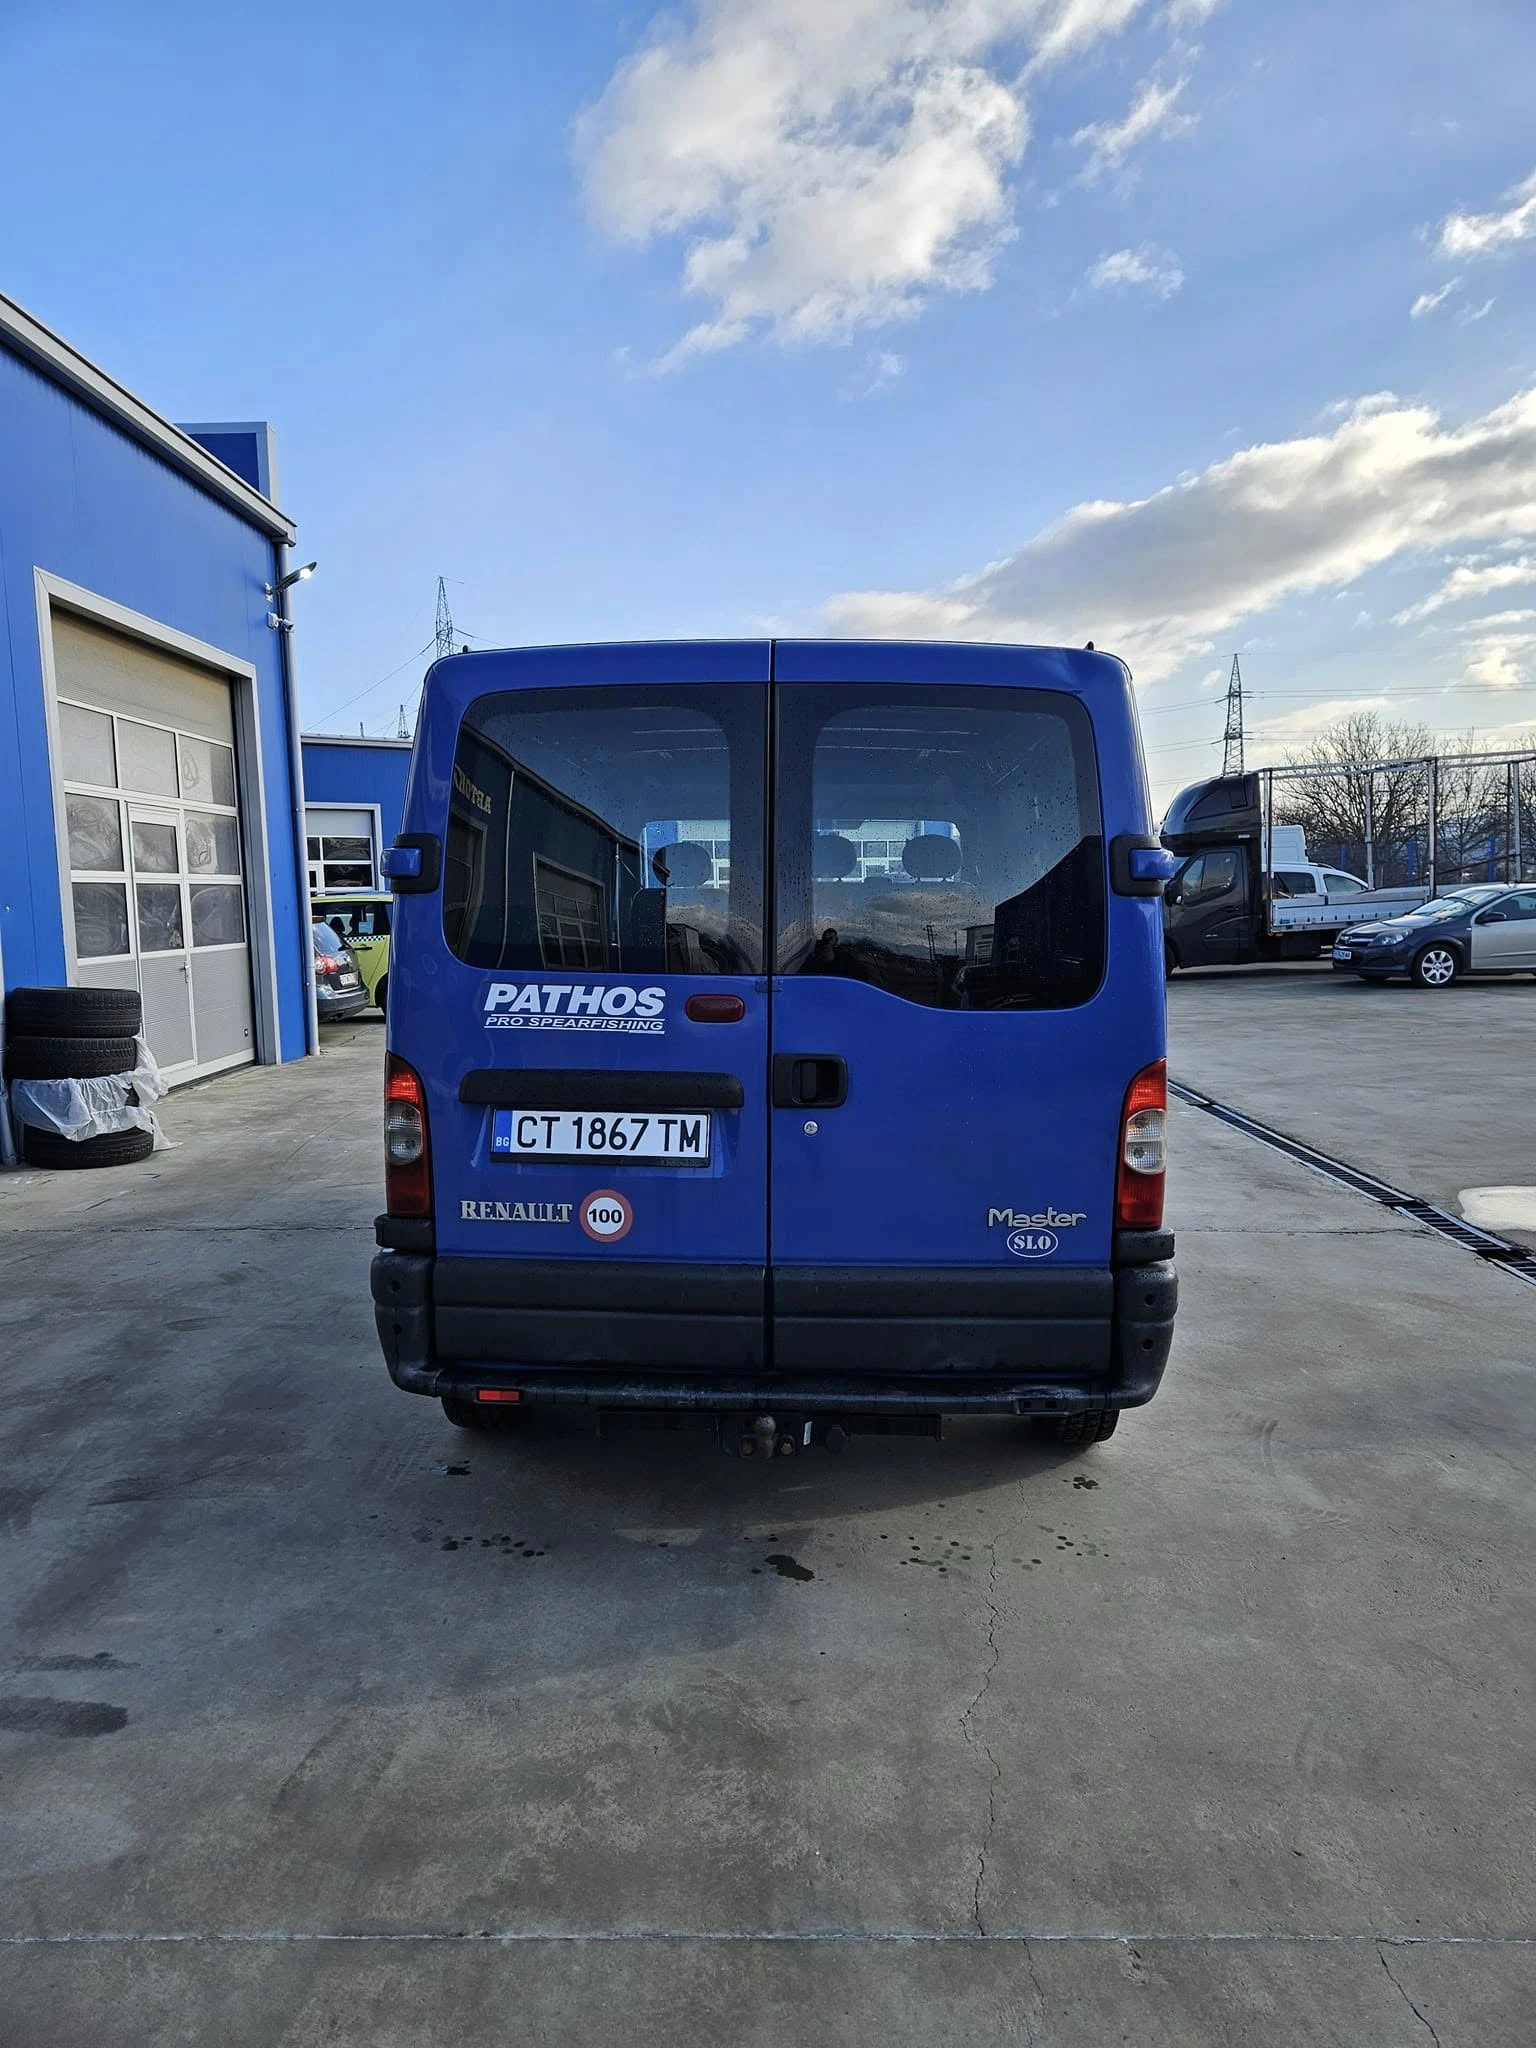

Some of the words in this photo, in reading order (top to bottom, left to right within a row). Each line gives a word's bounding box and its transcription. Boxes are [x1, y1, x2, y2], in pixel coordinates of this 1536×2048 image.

[484, 982, 667, 1017] PATHOS
[485, 1016, 525, 1027] PRO
[531, 1018, 664, 1032] SPEARFISHING
[495, 1136, 510, 1148] BG
[516, 1116, 561, 1149] CT
[572, 1117, 650, 1152] 1867
[658, 1119, 701, 1153] TM
[460, 1199, 573, 1223] RENAULT
[588, 1208, 623, 1225] 100
[988, 1206, 1087, 1228] Master
[1013, 1235, 1052, 1250] SLO
